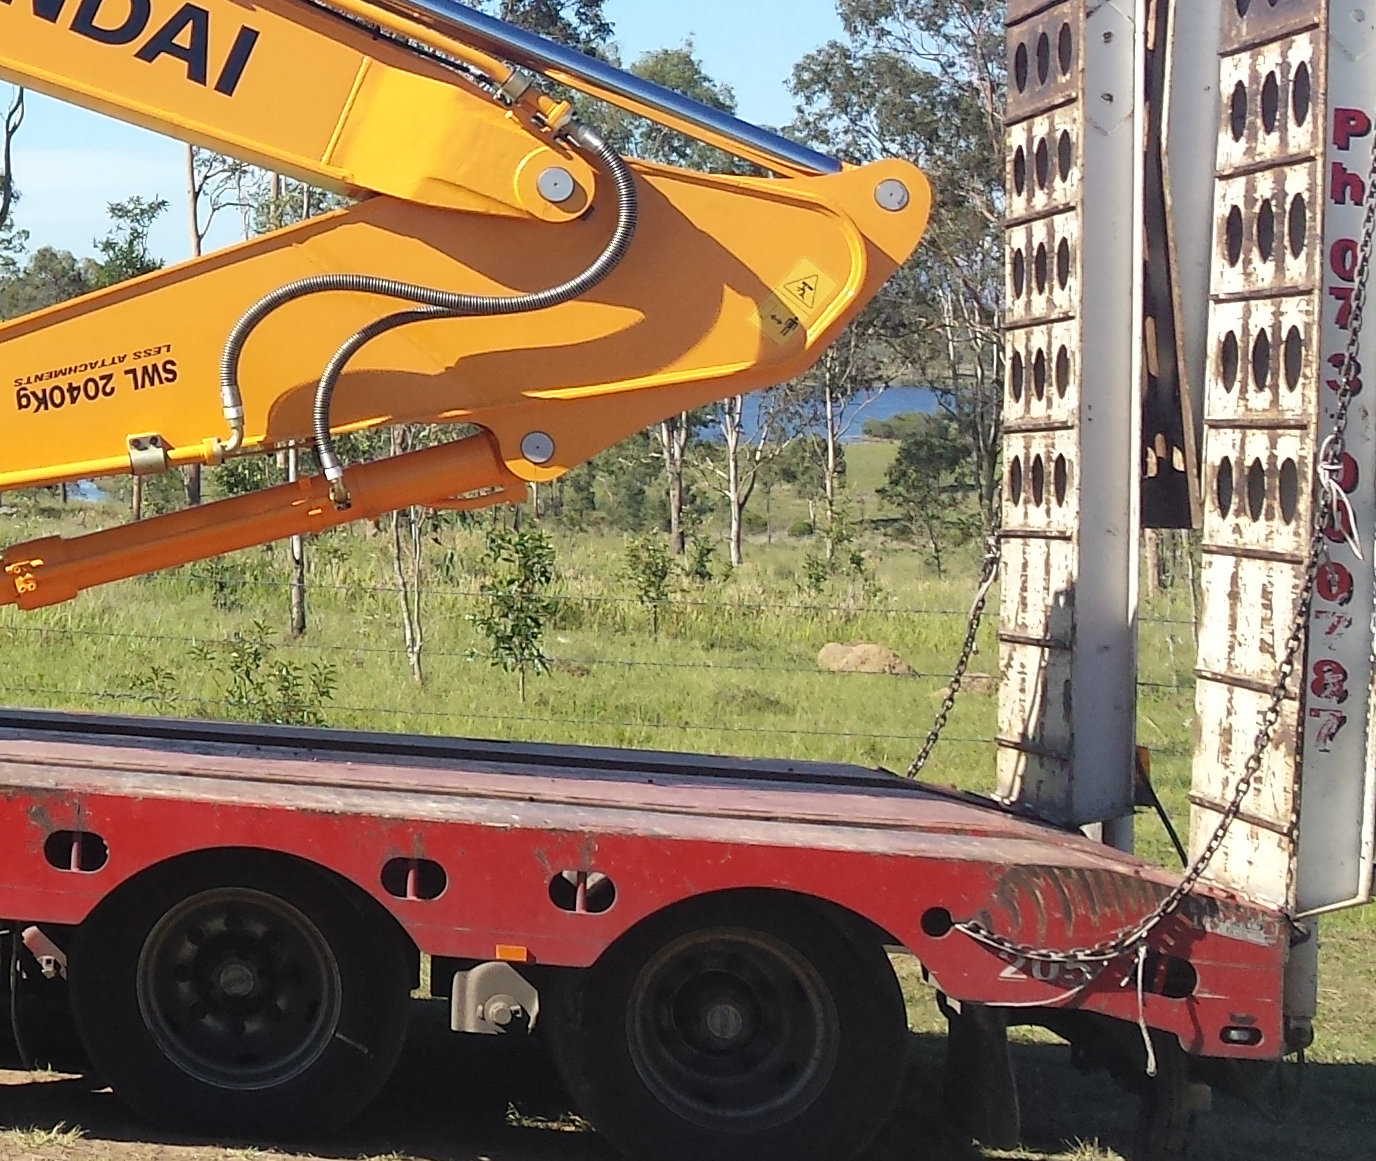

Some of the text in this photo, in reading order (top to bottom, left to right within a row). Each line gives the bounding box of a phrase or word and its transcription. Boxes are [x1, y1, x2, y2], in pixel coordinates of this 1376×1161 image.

[1330, 107, 1372, 206] Ph
[13, 344, 172, 387] LESS ATTACHMENTS
[16, 359, 178, 414] SWL 2040Kg
